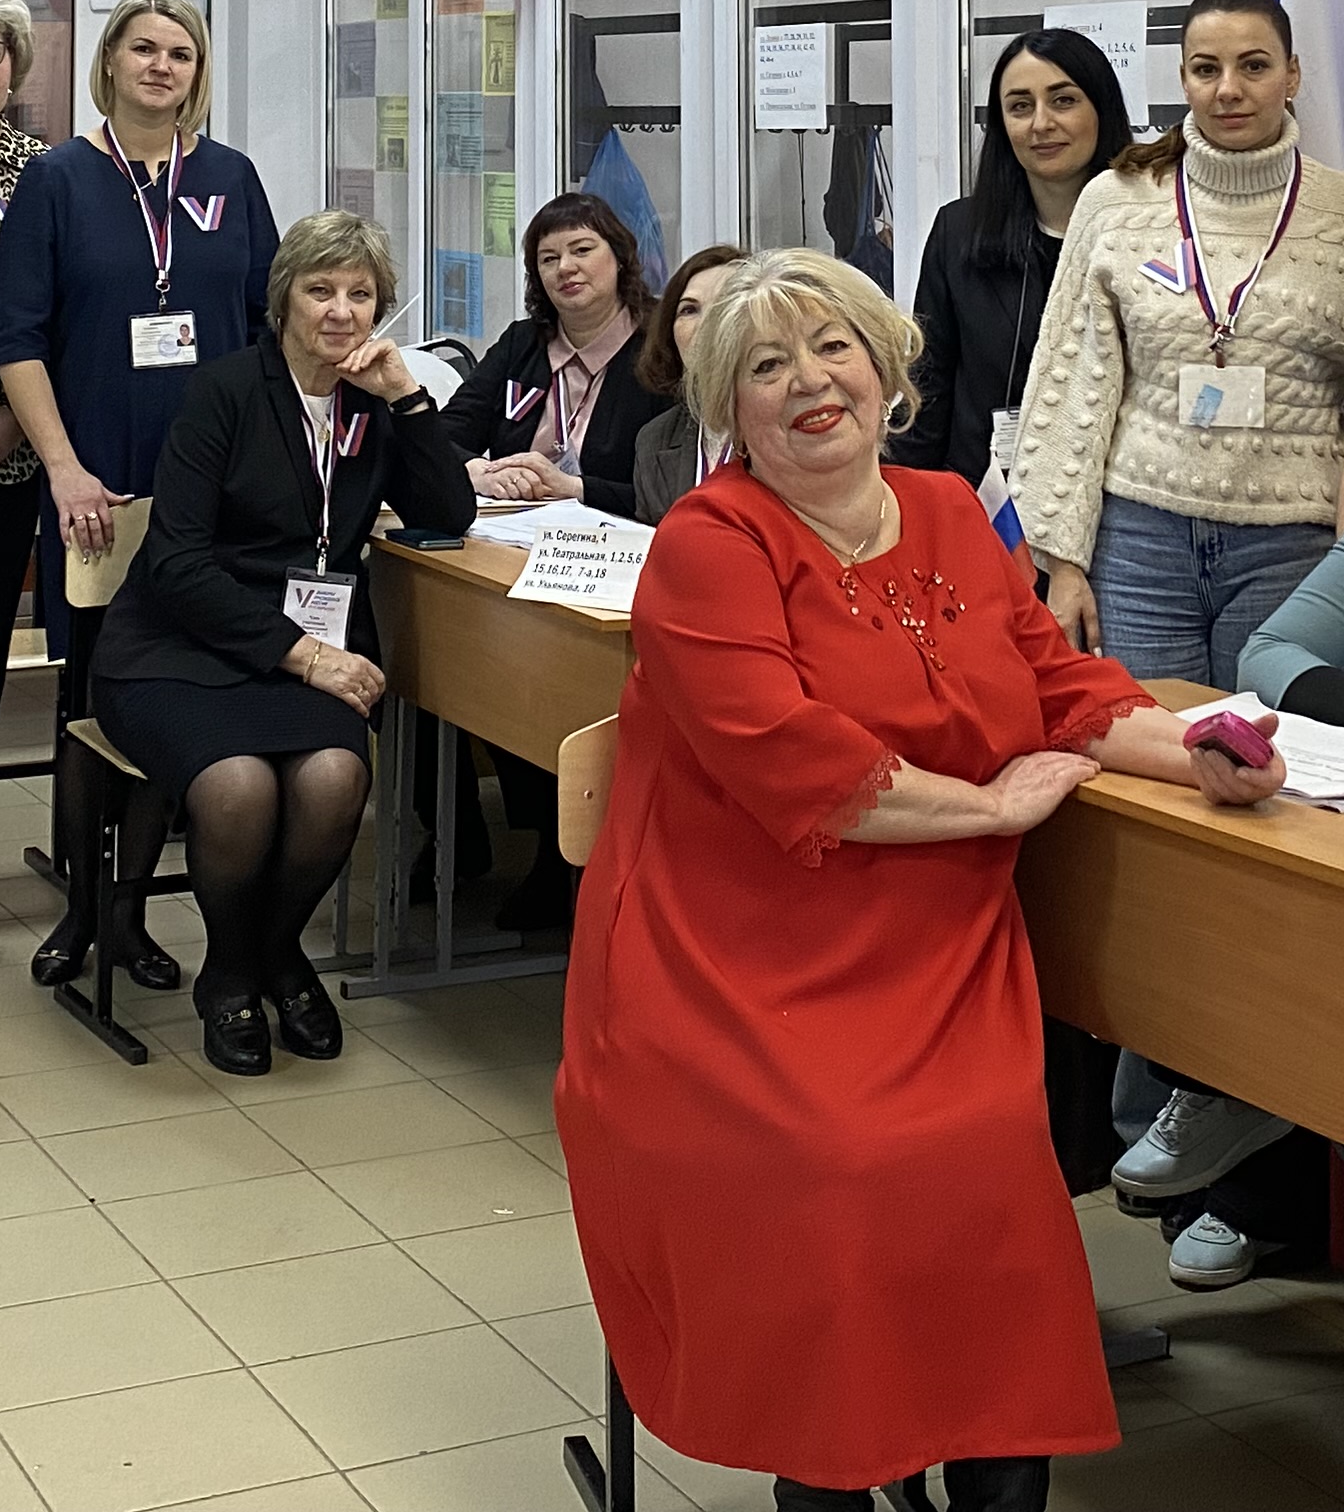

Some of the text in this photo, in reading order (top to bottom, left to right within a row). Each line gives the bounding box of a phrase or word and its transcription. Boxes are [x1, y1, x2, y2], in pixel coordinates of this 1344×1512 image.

[556, 529, 599, 544] Серегина,
[601, 532, 607, 543] 4
[552, 547, 607, 562] Театральная,
[583, 584, 596, 593] 10
